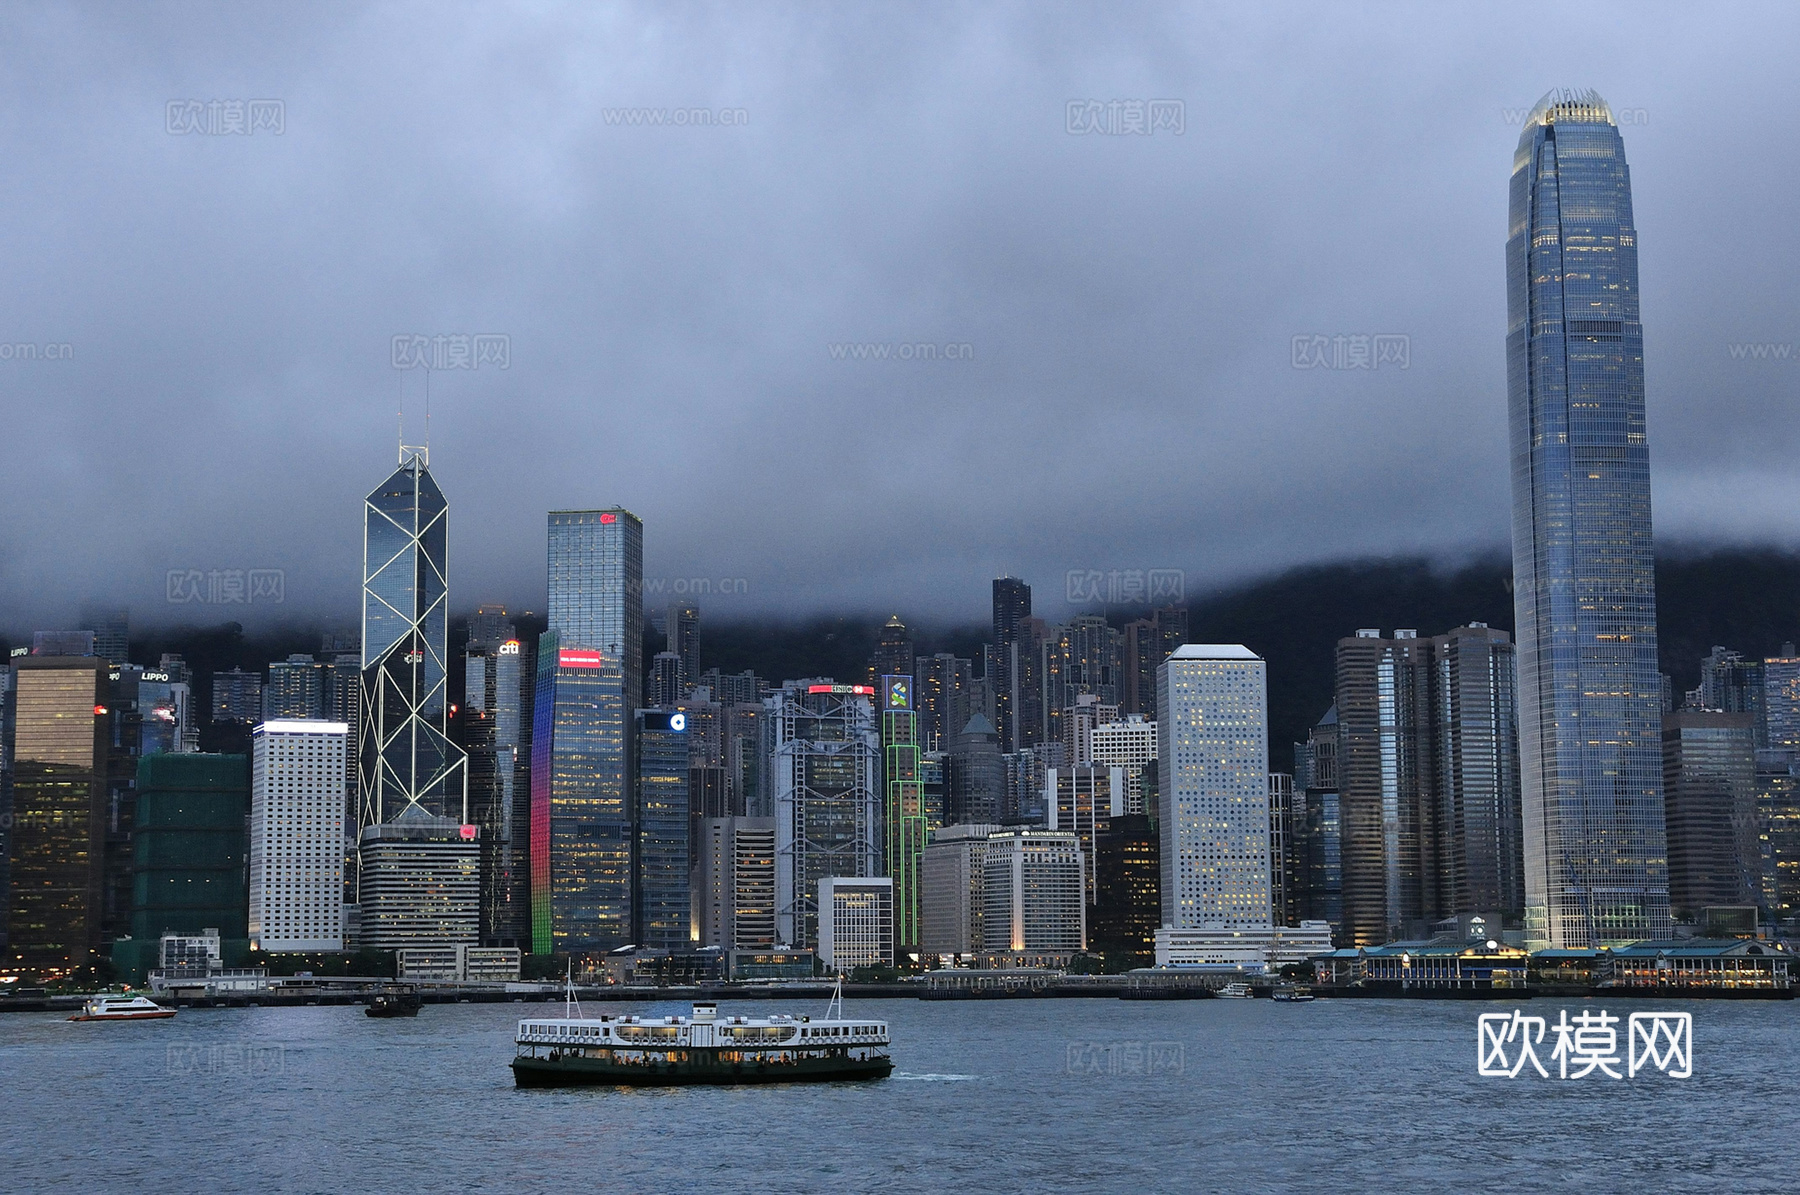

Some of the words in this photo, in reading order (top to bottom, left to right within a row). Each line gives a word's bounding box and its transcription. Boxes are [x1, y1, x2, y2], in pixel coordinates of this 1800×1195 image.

[11, 648, 28, 658] LIPPO
[499, 642, 519, 655] citi
[141, 672, 169, 682] LIPPO
[832, 685, 853, 694] HSBC
